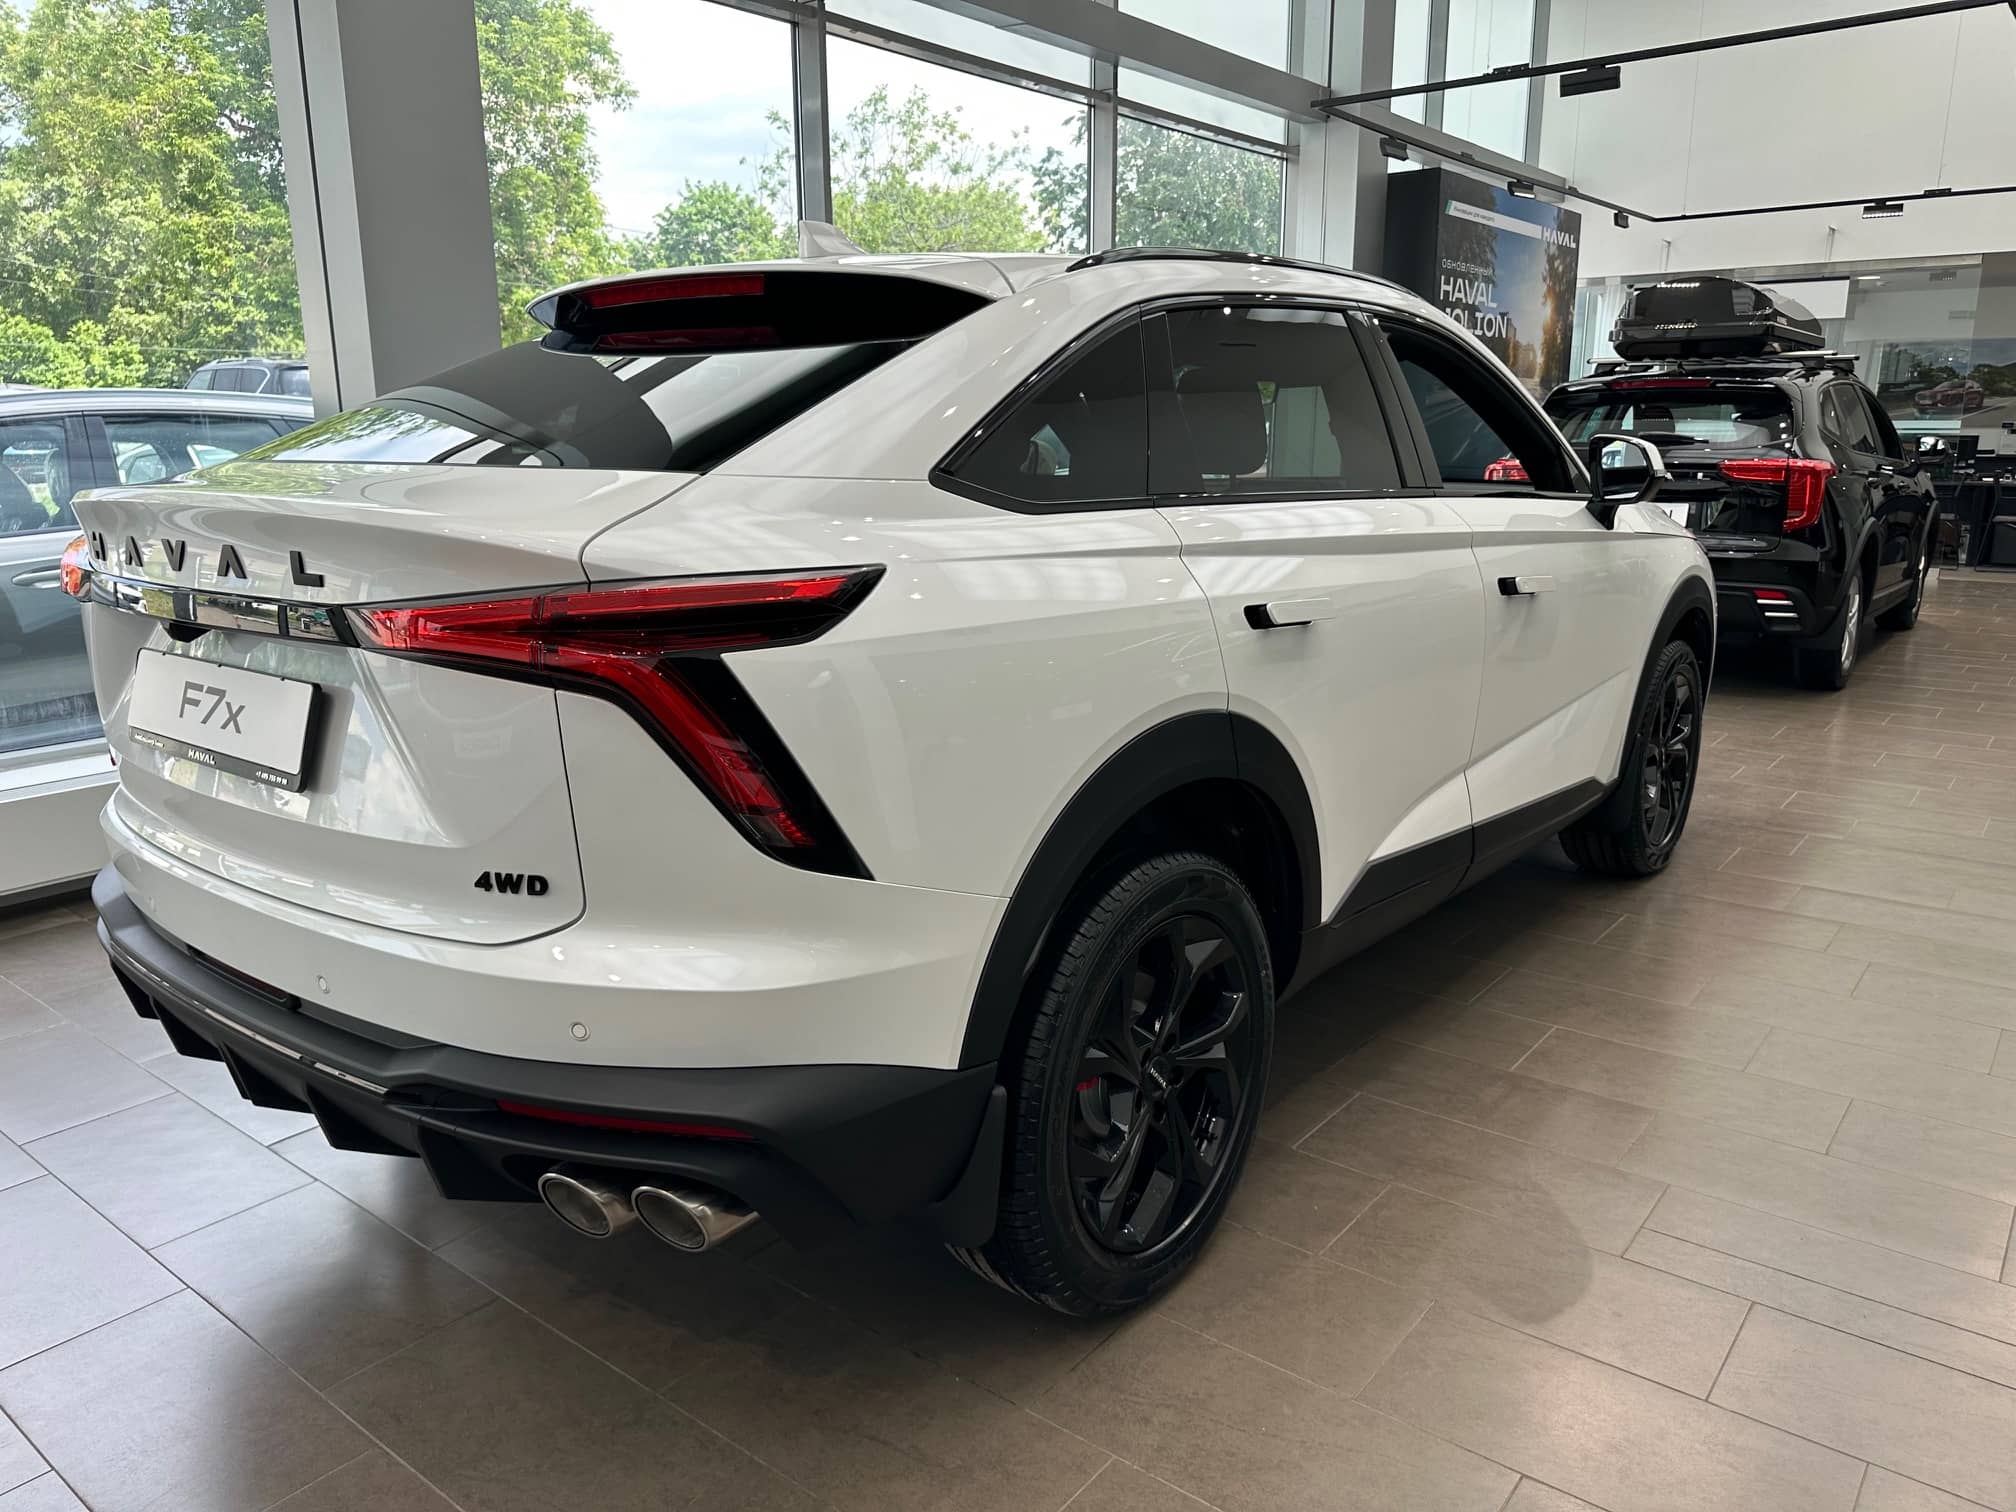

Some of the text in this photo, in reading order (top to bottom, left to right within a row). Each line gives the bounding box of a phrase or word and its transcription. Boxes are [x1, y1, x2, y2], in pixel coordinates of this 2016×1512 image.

[1543, 227, 1576, 248] HAVAL
[1440, 275, 1497, 308] HAVAL
[92, 531, 325, 588] HAVAL
[187, 749, 215, 765] HAVAL
[474, 871, 549, 896] 4WD
